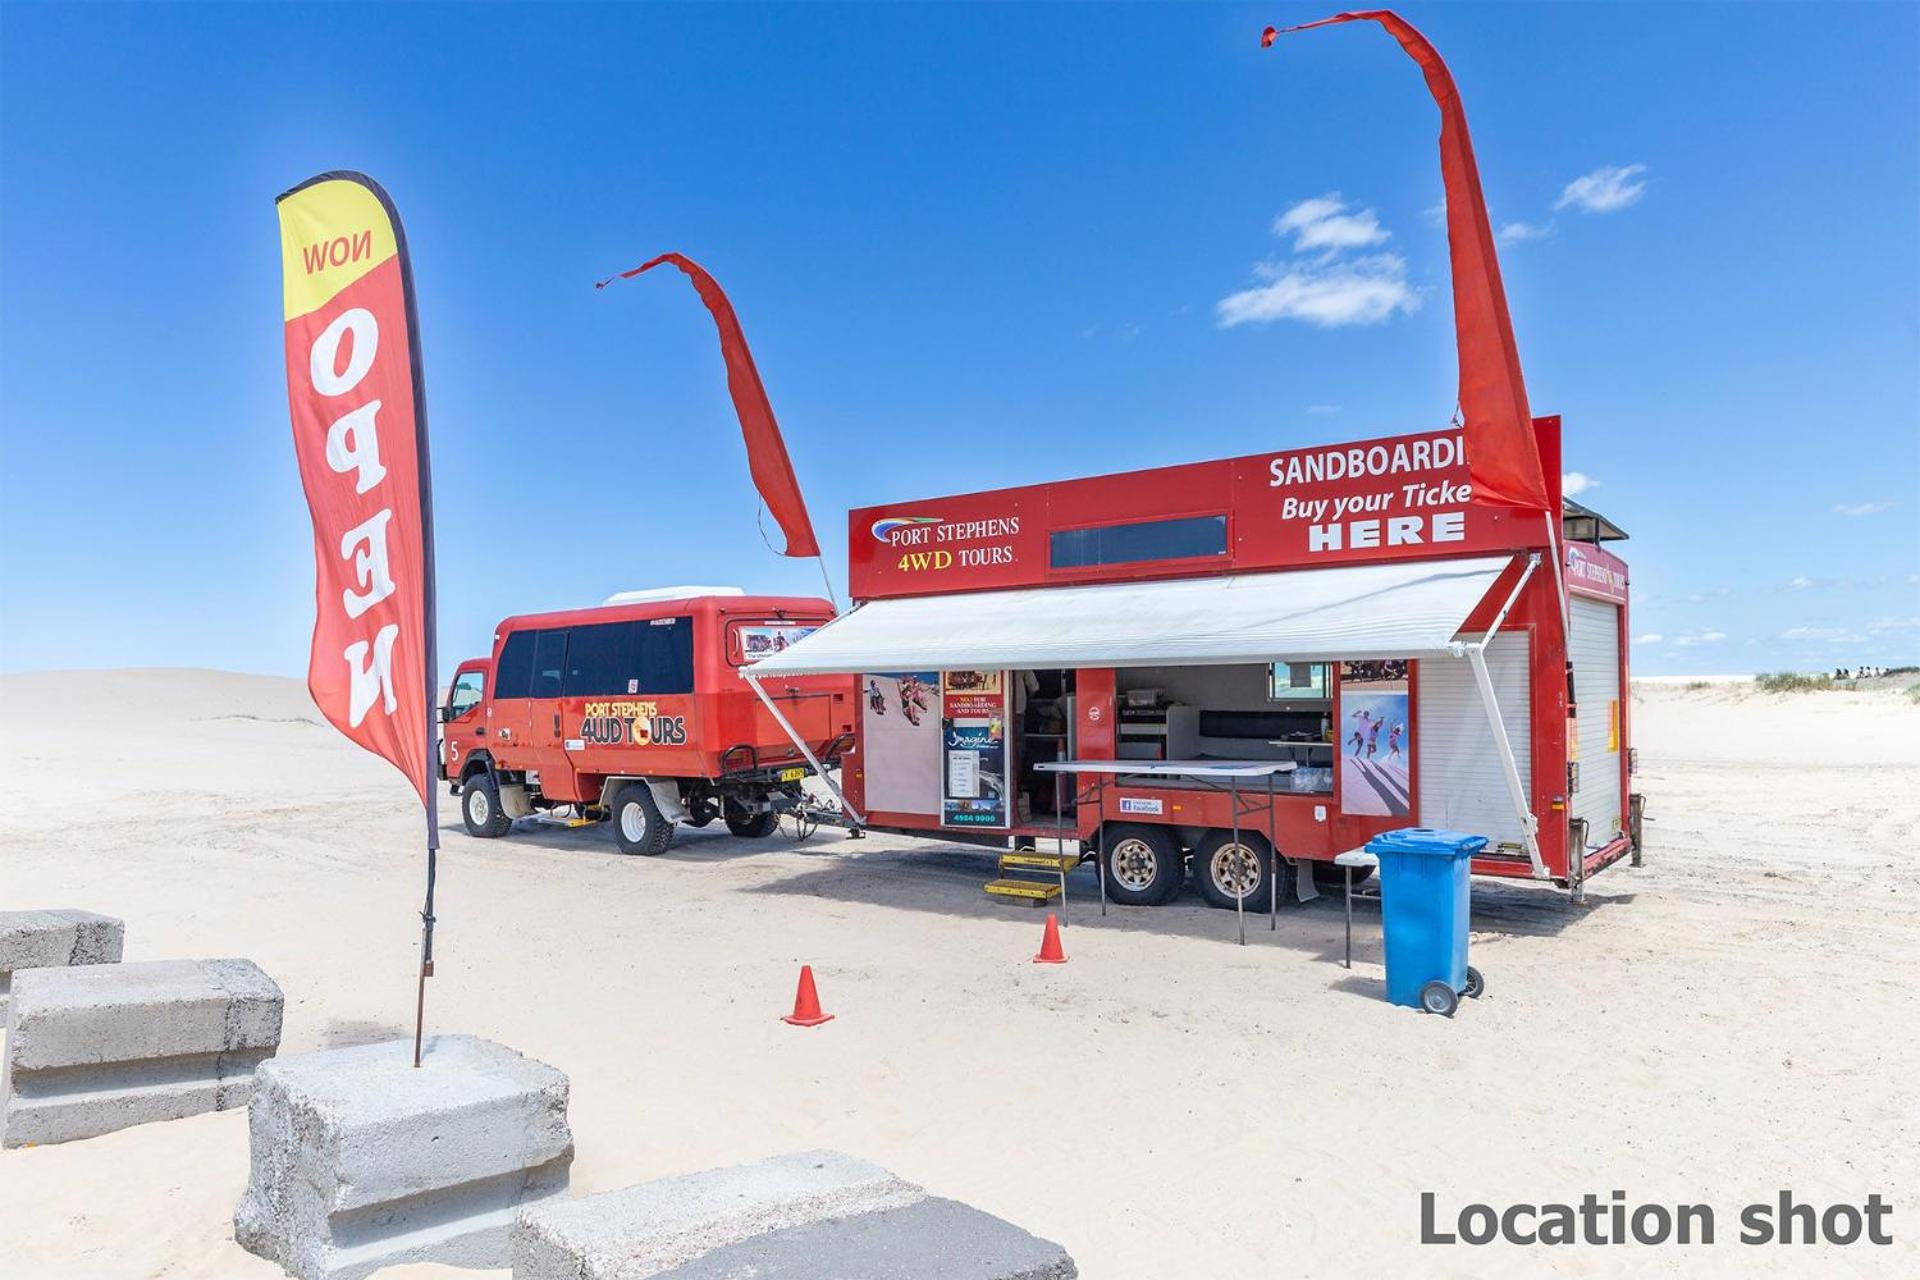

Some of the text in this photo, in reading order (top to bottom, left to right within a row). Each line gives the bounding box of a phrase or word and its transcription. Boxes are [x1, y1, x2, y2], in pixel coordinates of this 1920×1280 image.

[1269, 436, 1468, 488] SANDBOARDI
[1281, 480, 1472, 523] Buy your Ticke
[892, 517, 1020, 547] PORT STEPHENS
[1308, 511, 1465, 552] HERE
[898, 546, 1013, 572] 4WD TOURS
[585, 701, 658, 718] PORT STEPHENS
[580, 716, 624, 745] 4WD
[451, 740, 459, 761] 5
